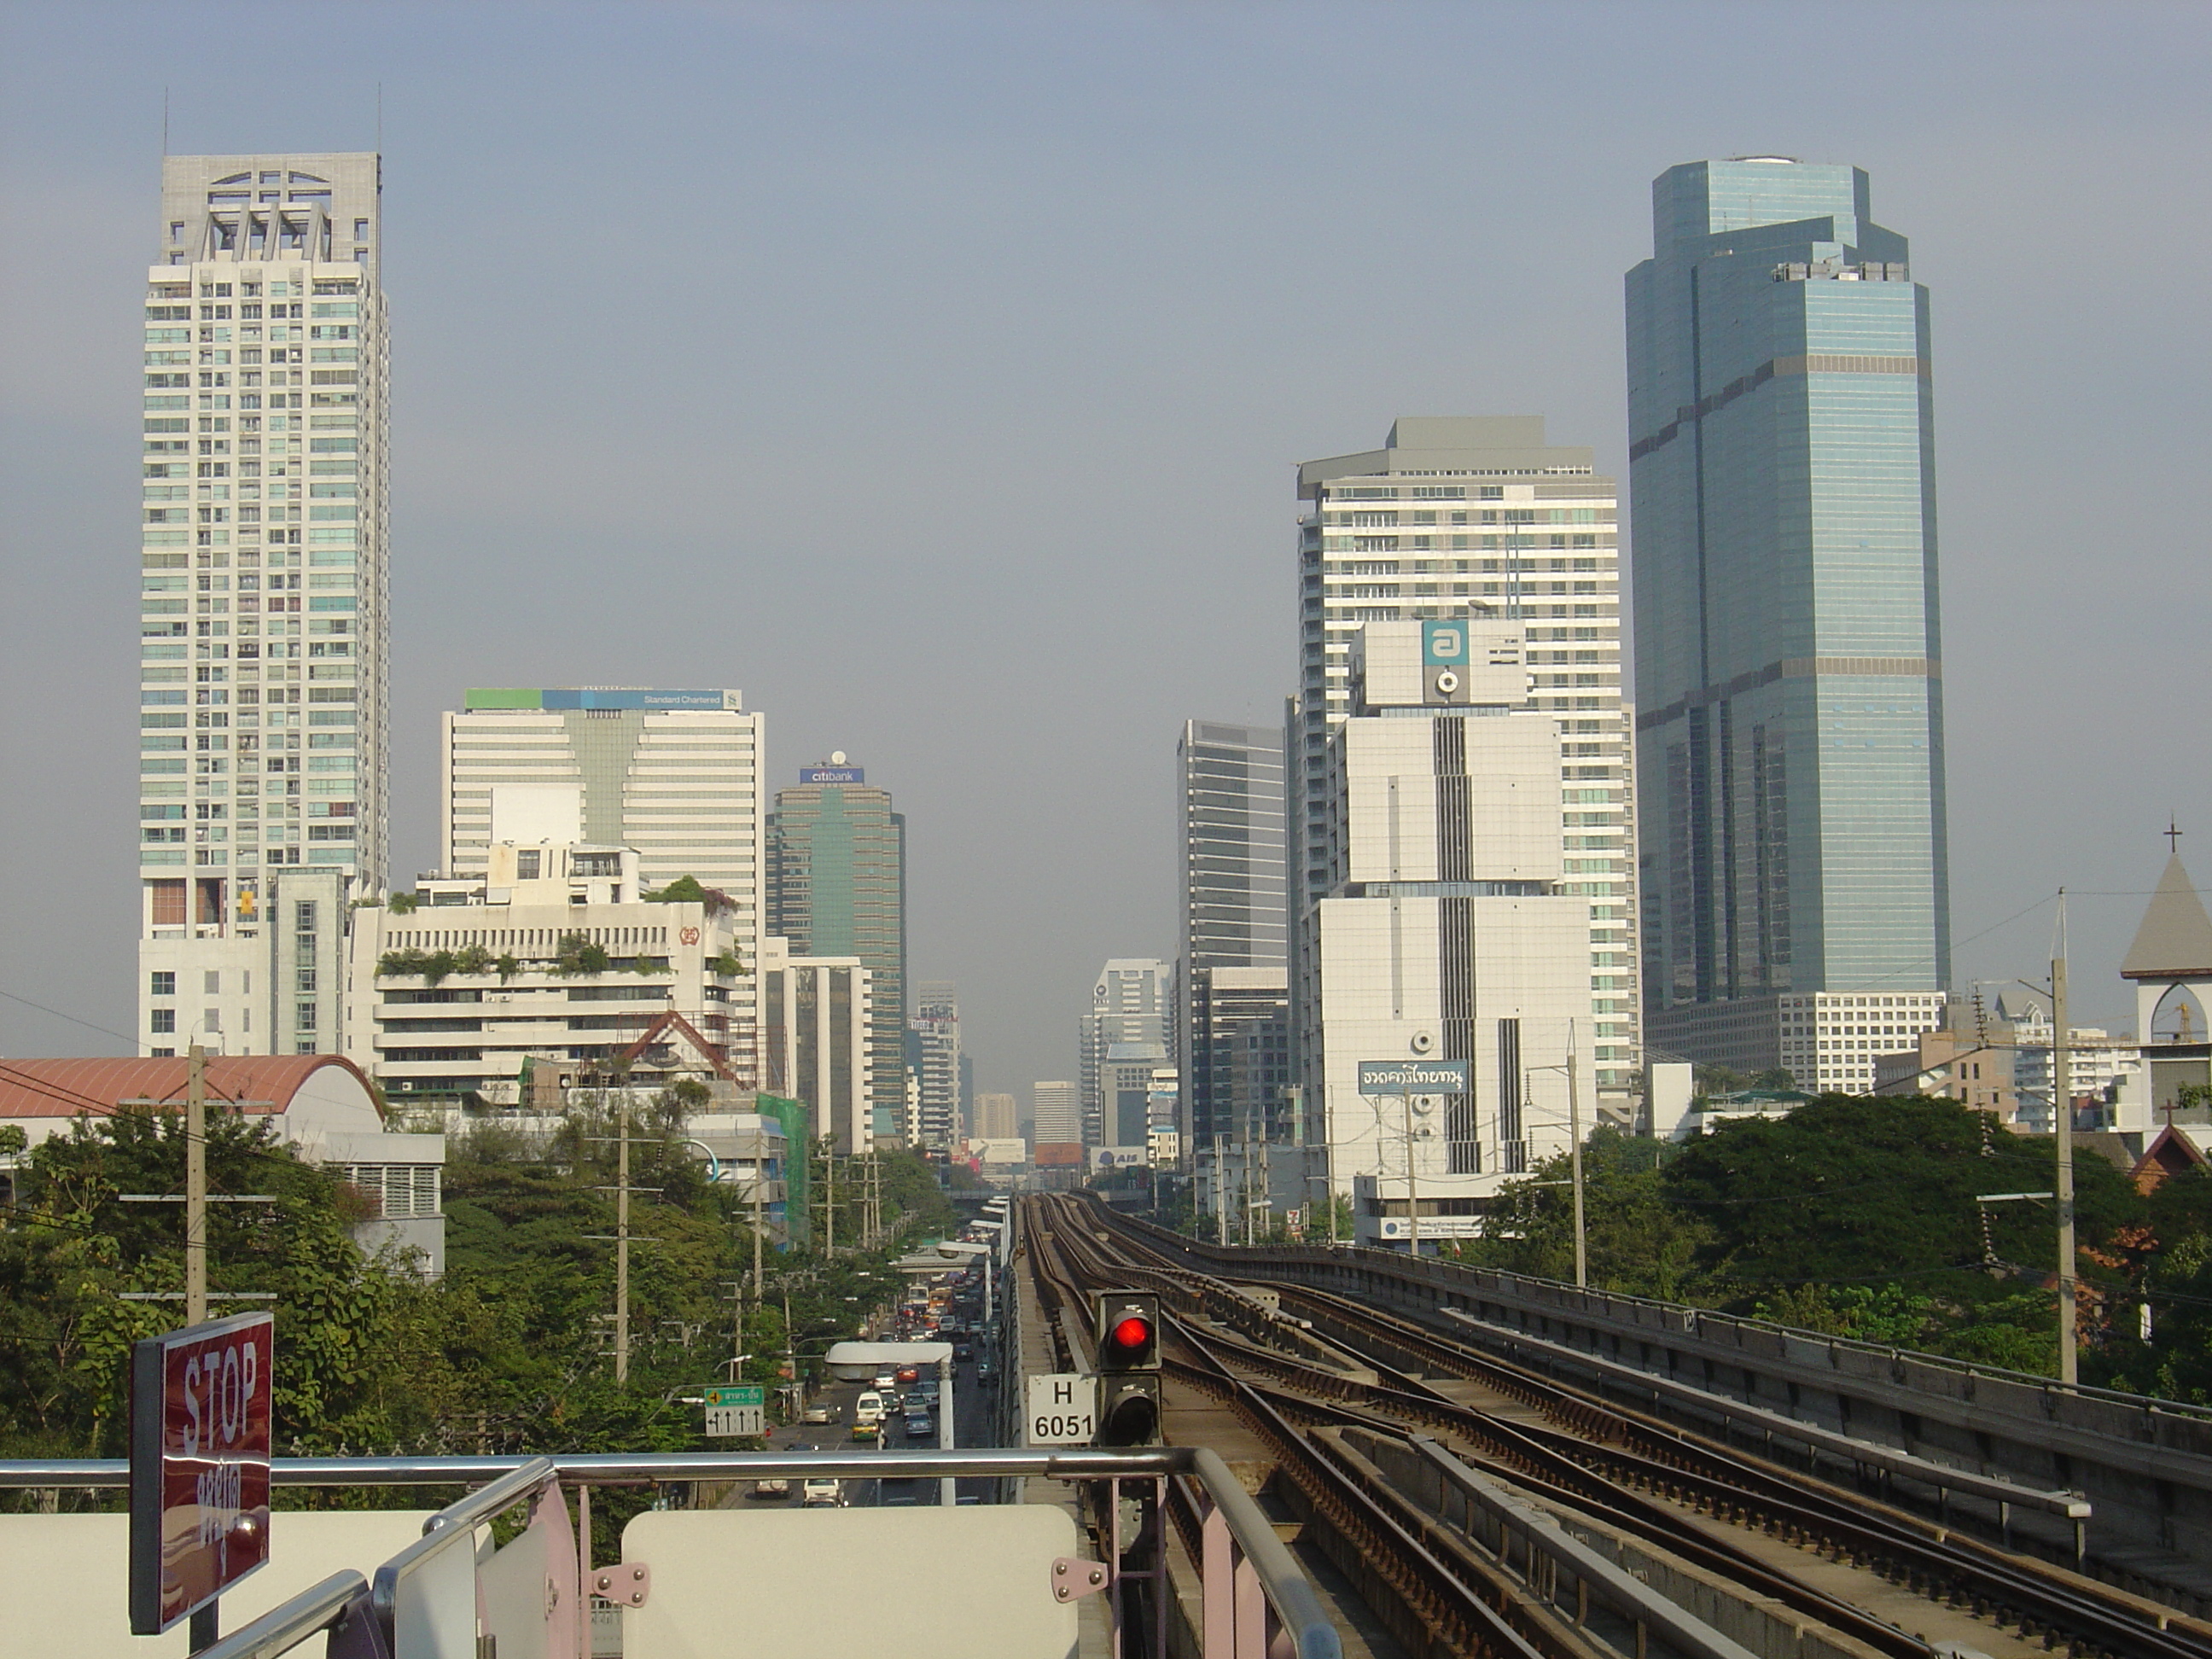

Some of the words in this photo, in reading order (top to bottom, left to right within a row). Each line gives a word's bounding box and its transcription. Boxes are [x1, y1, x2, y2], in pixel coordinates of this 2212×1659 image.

[644, 696, 680, 704] Standard
[681, 696, 720, 704] Chartered
[812, 771, 853, 782] citibank
[1116, 1154, 1138, 1162] AIS
[183, 1342, 257, 1458] STOP
[1054, 1382, 1072, 1405] H
[1035, 1415, 1091, 1437] 6051
[196, 1464, 242, 1577] หยุด
